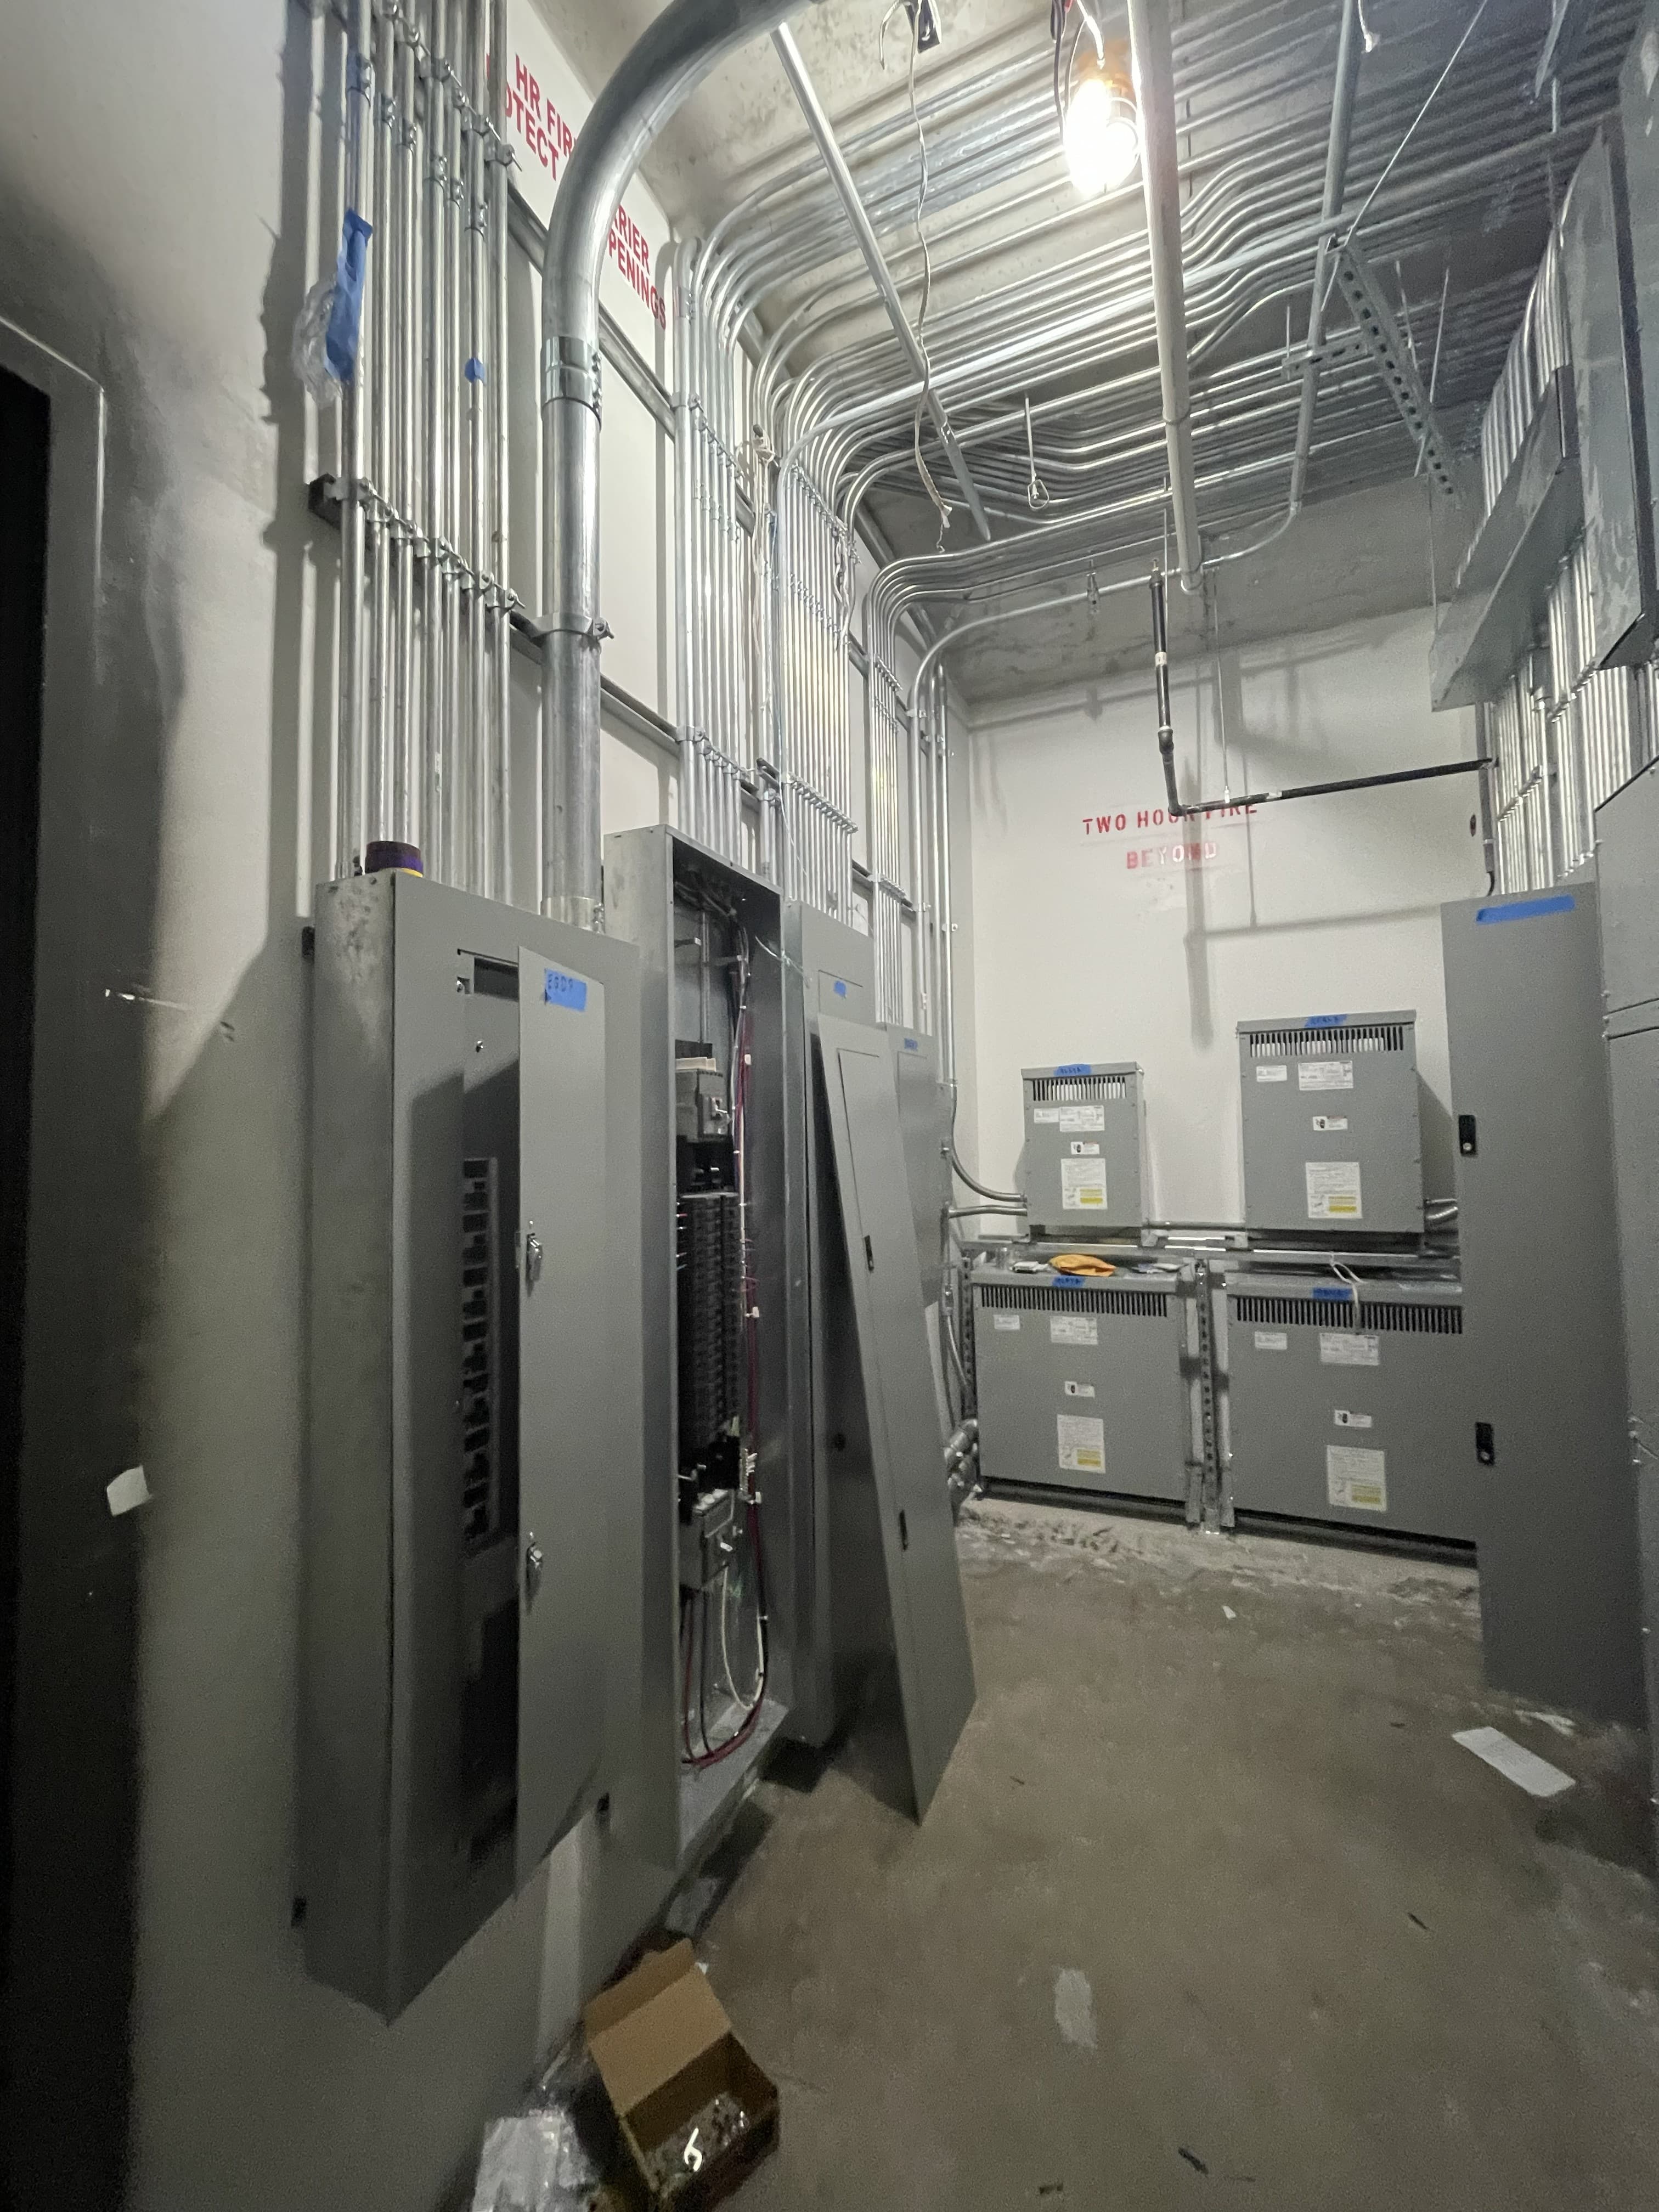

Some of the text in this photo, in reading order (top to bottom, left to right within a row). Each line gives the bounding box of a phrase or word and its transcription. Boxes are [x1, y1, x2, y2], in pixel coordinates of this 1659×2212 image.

[505, 82, 666, 330] OTECT PENINGS
[516, 53, 650, 275] HR FIR RIER
[1082, 814, 1126, 835] TWO
